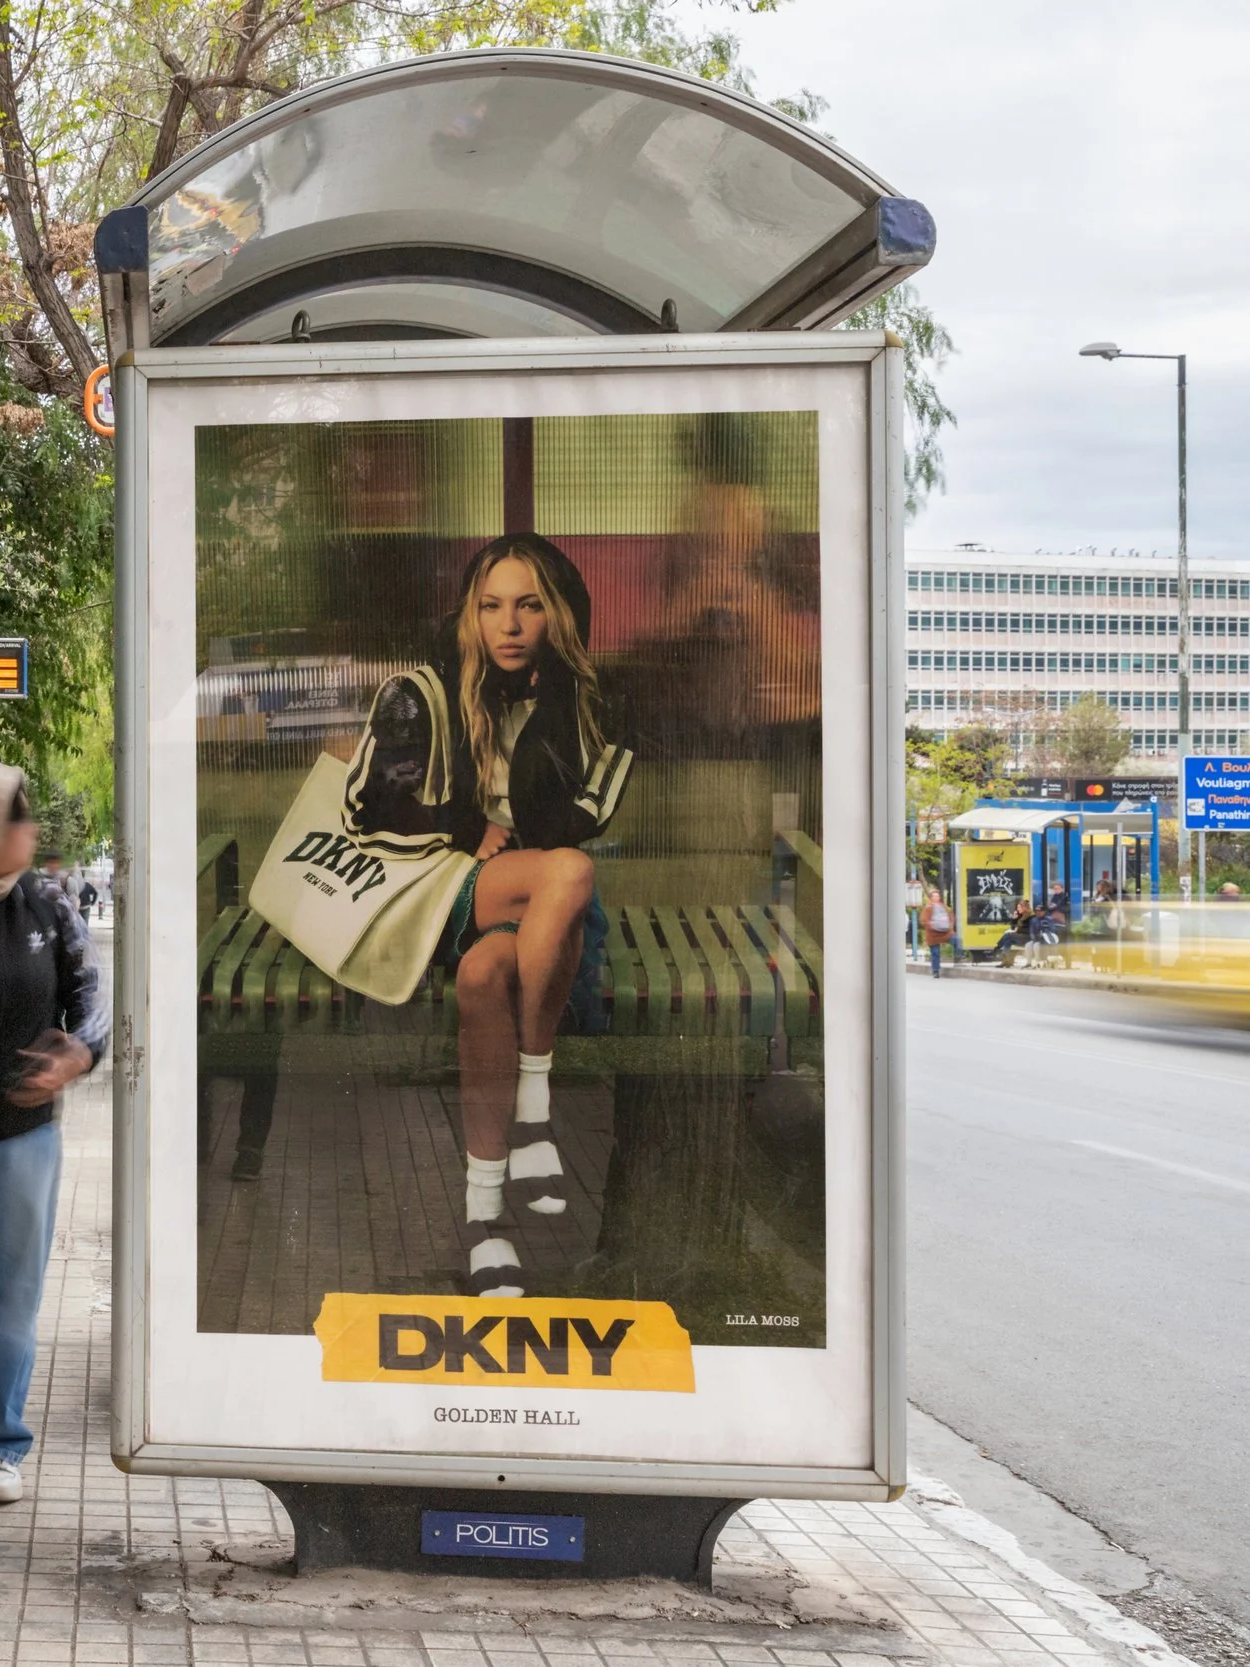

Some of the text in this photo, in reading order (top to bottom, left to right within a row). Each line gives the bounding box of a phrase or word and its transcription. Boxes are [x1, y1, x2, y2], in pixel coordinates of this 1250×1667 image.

[282, 831, 387, 903] DKNY
[302, 871, 338, 897] NEW YORK
[725, 1314, 800, 1327] LILA MOSS
[378, 1313, 636, 1376] DKNY
[433, 1406, 581, 1427] GOLDEN HALL
[456, 1524, 549, 1548] POLITIS
